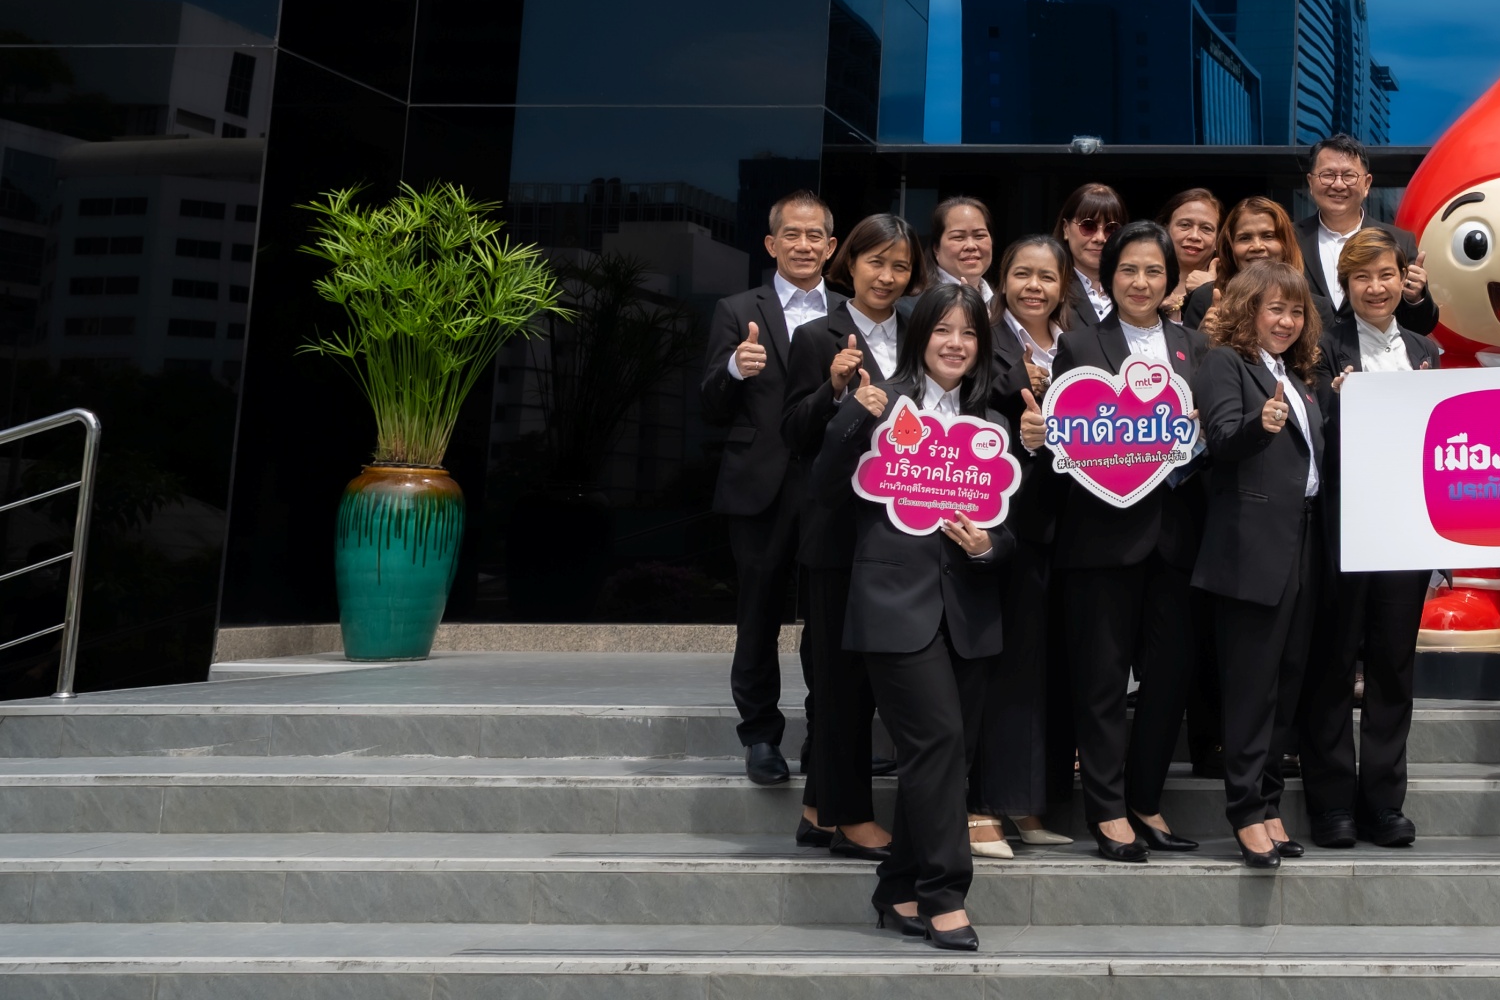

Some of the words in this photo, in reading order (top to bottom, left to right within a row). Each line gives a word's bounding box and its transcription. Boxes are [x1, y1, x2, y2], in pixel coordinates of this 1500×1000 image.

[1135, 377, 1152, 387] mtl
[1047, 403, 1195, 444] มาด้วยใจ
[928, 438, 960, 460] ร่วม
[885, 458, 992, 486] บริจาคโลหิต
